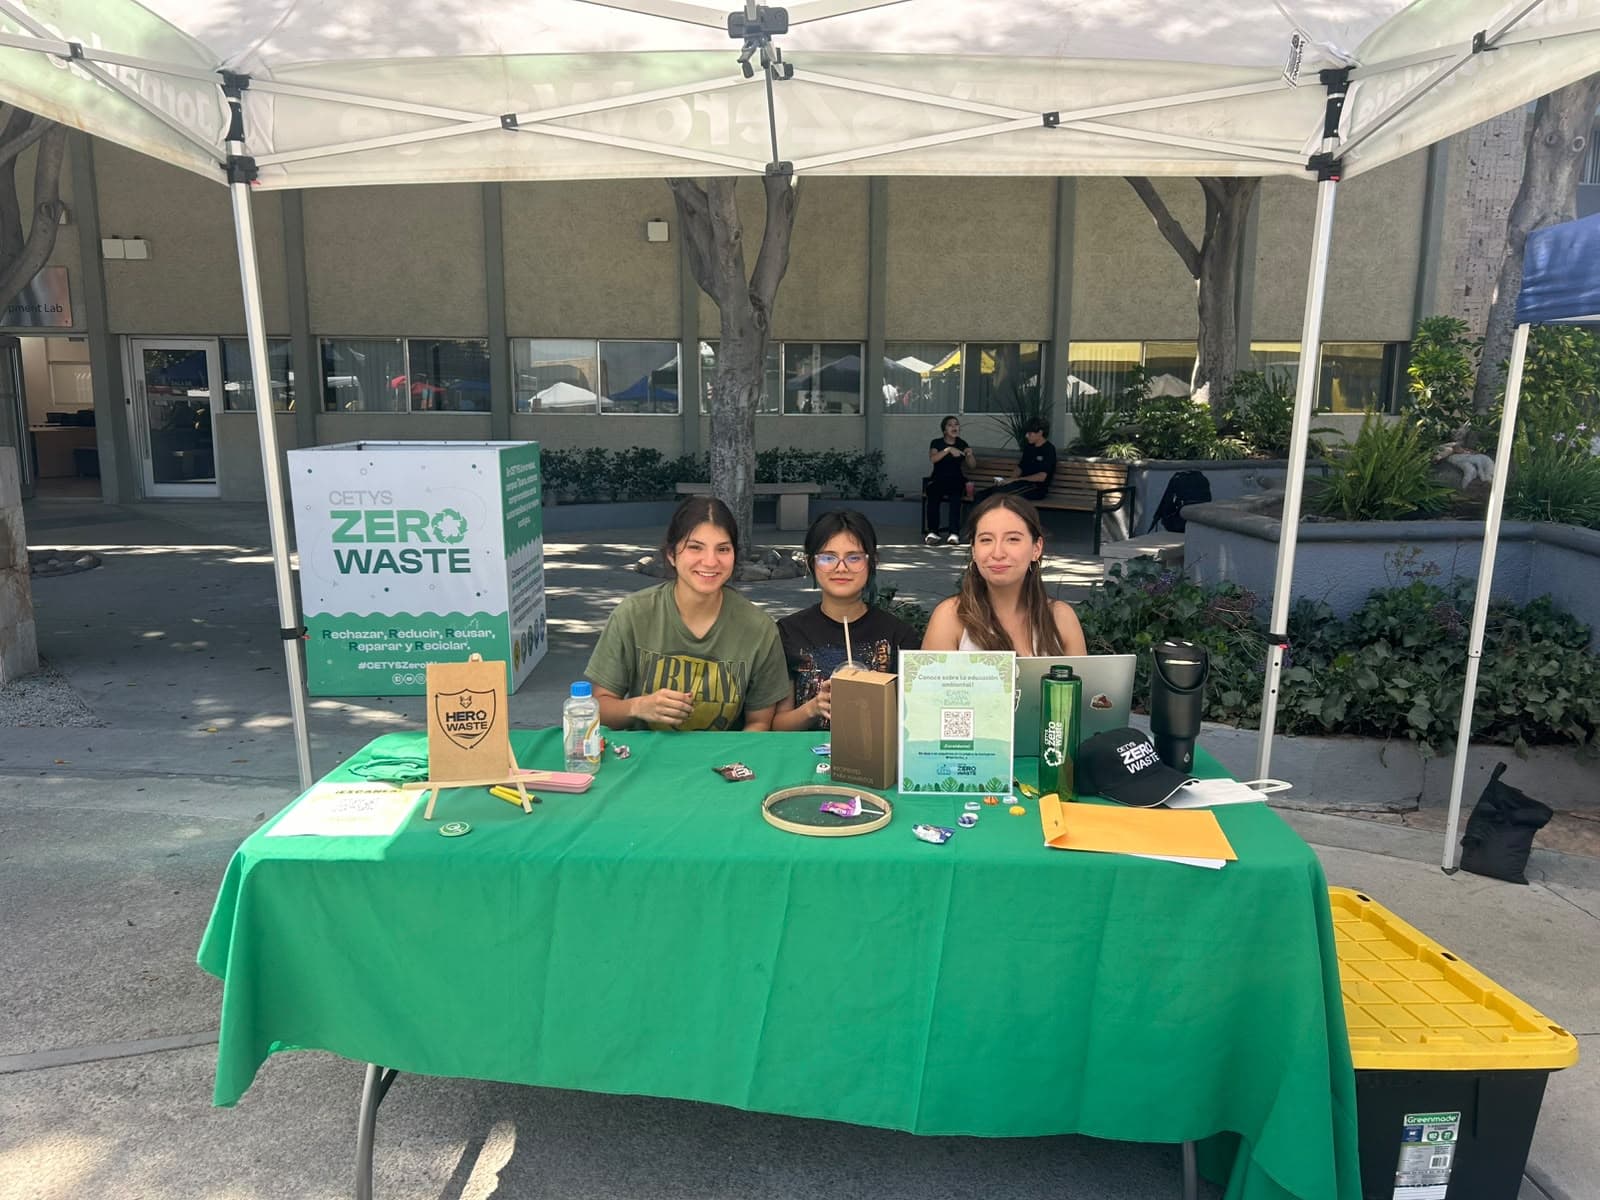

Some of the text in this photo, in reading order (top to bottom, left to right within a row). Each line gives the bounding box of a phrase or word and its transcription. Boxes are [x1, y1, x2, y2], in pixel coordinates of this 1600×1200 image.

[44, 303, 63, 313] Lab
[328, 490, 393, 506] CETYS
[329, 508, 469, 545] ZERO
[333, 548, 471, 574] WASTE
[322, 628, 496, 641] Rechazar, Reducir, Reusar,
[348, 640, 471, 653] Reparar y Reciclar.
[358, 661, 437, 670] #CETYSZero
[445, 710, 487, 722] HERO
[446, 721, 488, 731] WASTE
[1120, 741, 1154, 765] ZERO
[1126, 751, 1160, 774] WASTE
[1407, 1115, 1457, 1124] Greenmade
